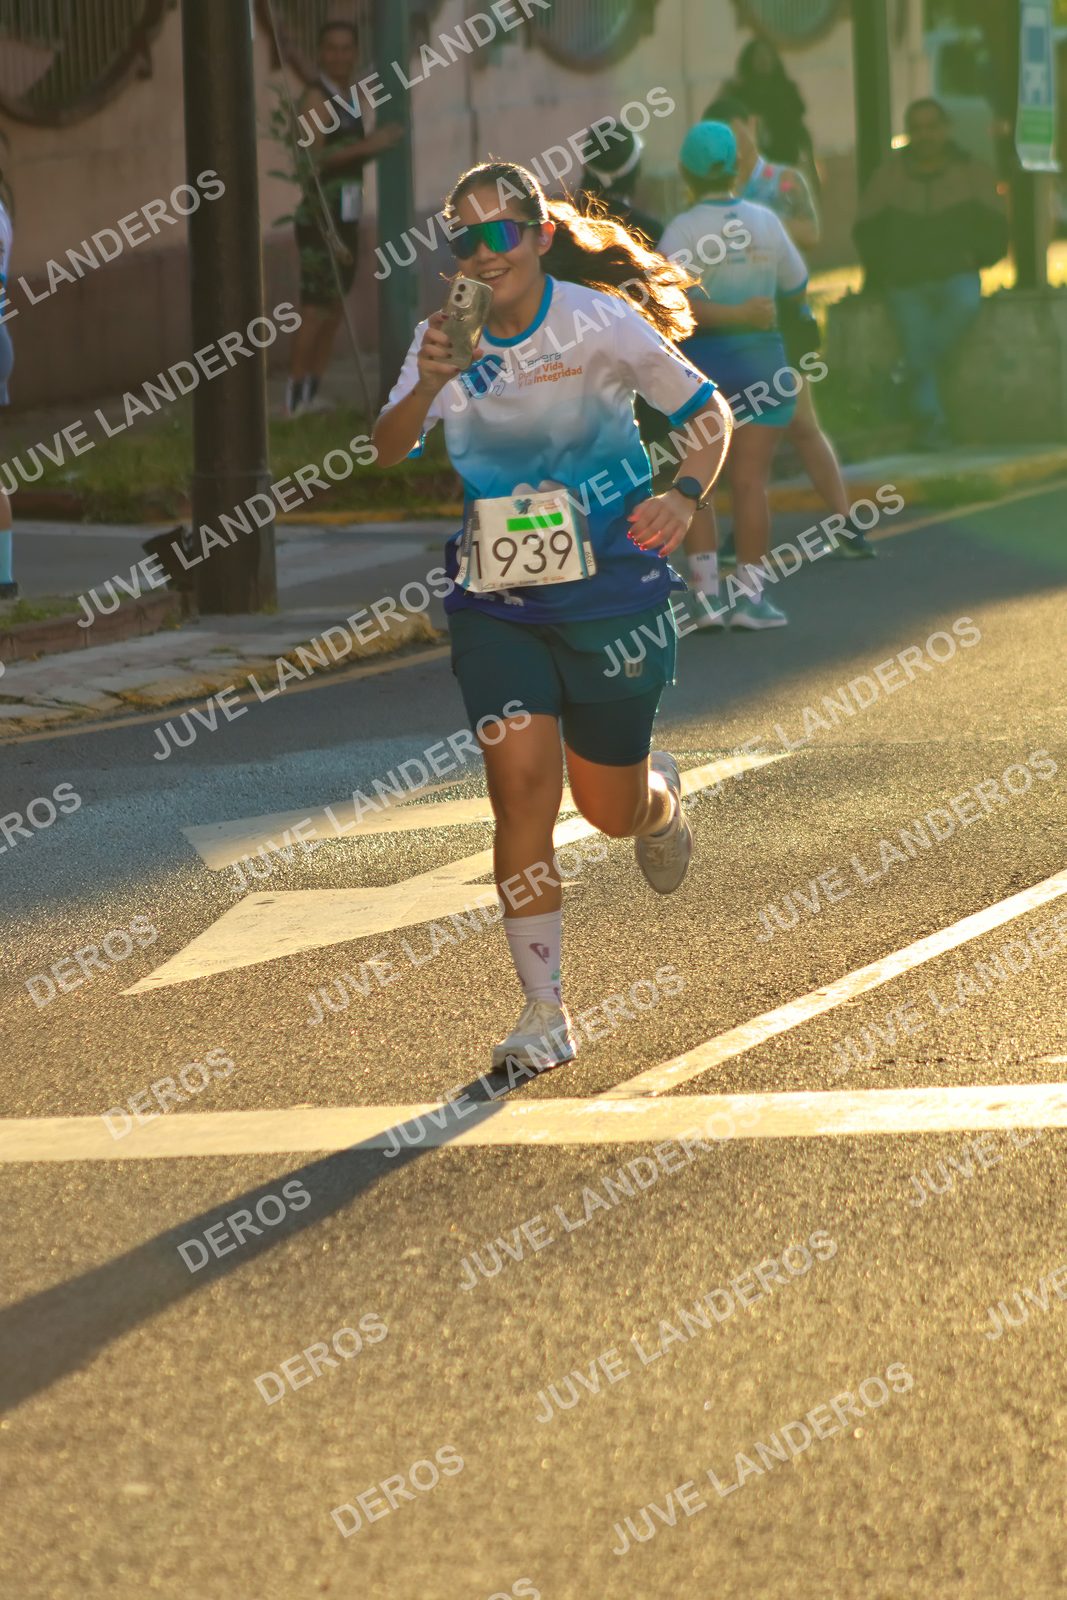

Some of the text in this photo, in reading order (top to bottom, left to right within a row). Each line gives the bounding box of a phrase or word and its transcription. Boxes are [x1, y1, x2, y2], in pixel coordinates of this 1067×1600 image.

[533, 365, 583, 384] Integridad
[542, 361, 564, 372] Vida
[472, 530, 573, 580] 1939
[584, 551, 593, 568] 1939
